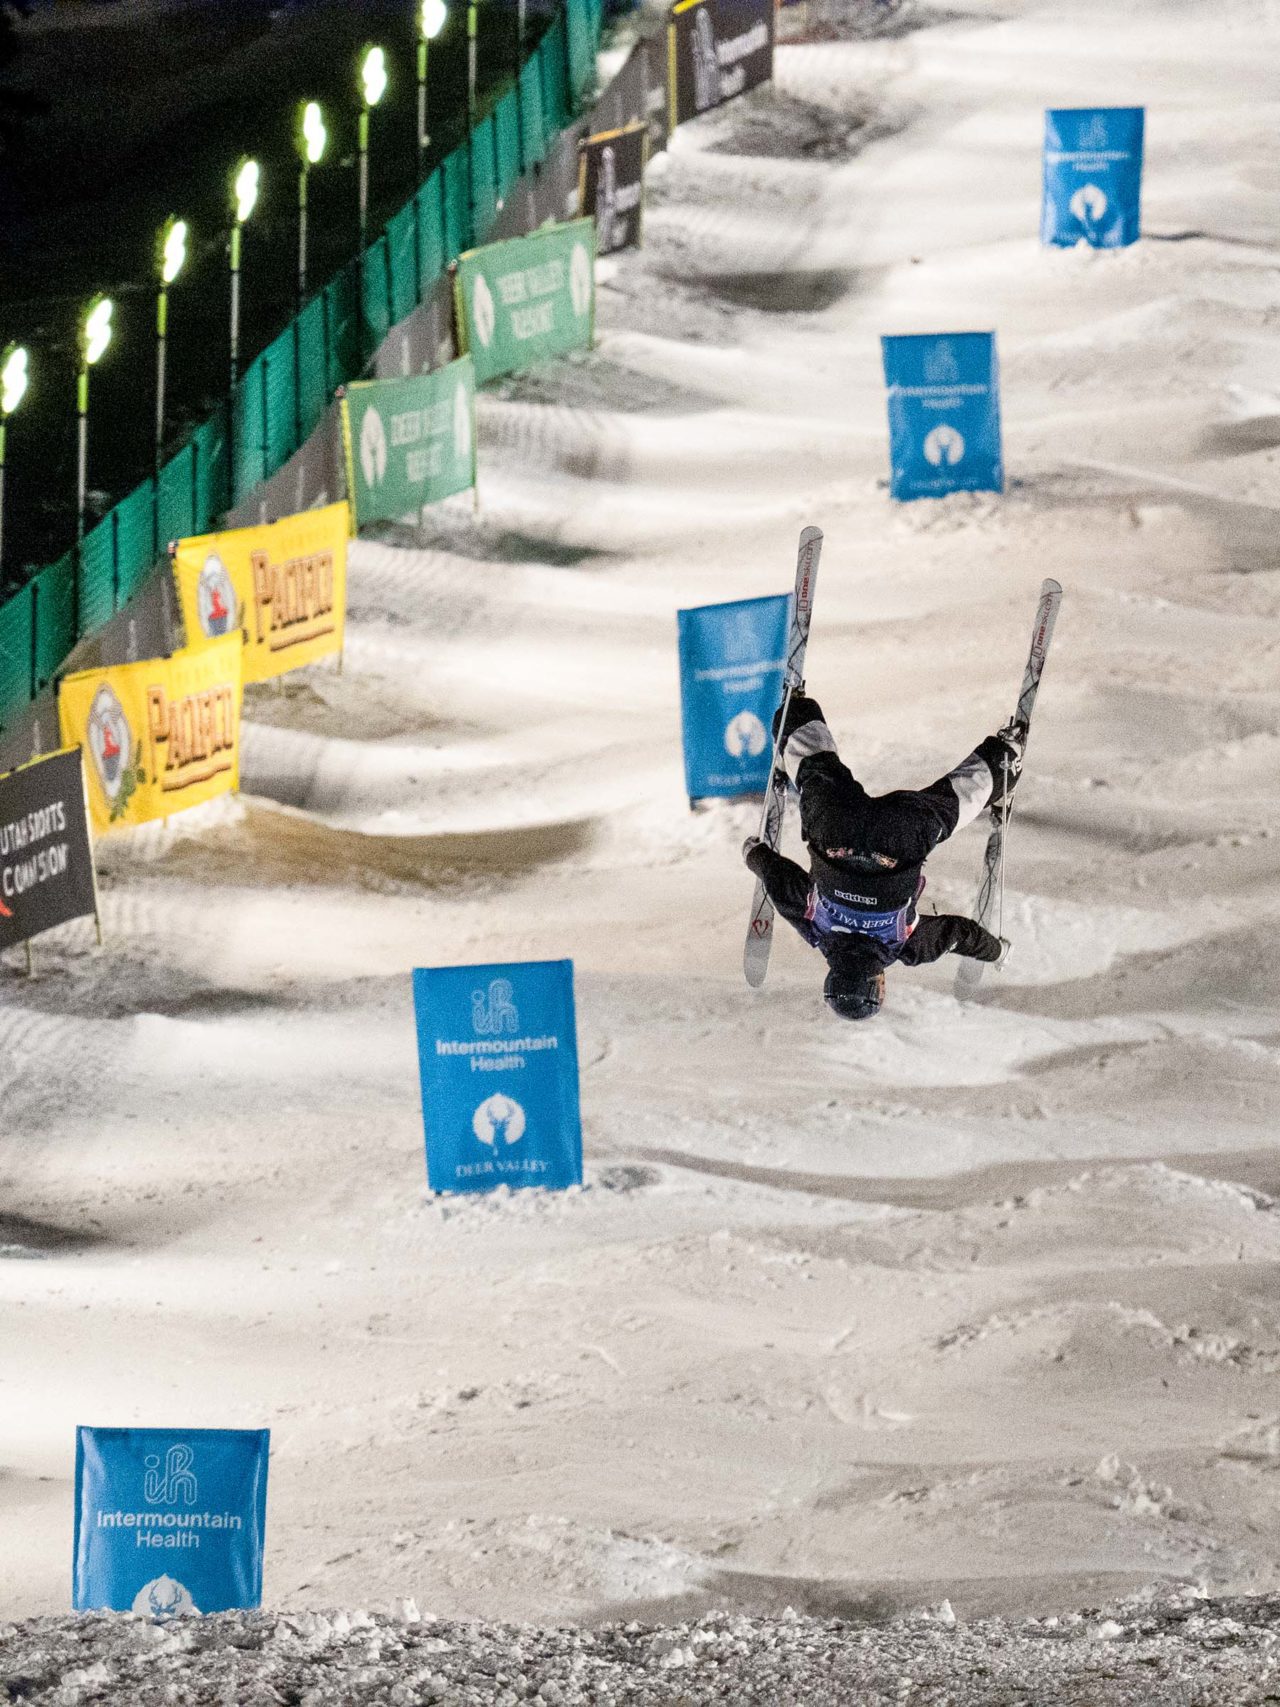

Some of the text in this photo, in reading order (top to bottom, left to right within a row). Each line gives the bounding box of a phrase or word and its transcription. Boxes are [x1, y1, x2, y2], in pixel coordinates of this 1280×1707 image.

[436, 1035, 558, 1055] Intermountain
[470, 1055, 525, 1072] Health
[97, 1510, 242, 1530] Intermountain
[137, 1530, 201, 1549] Health
